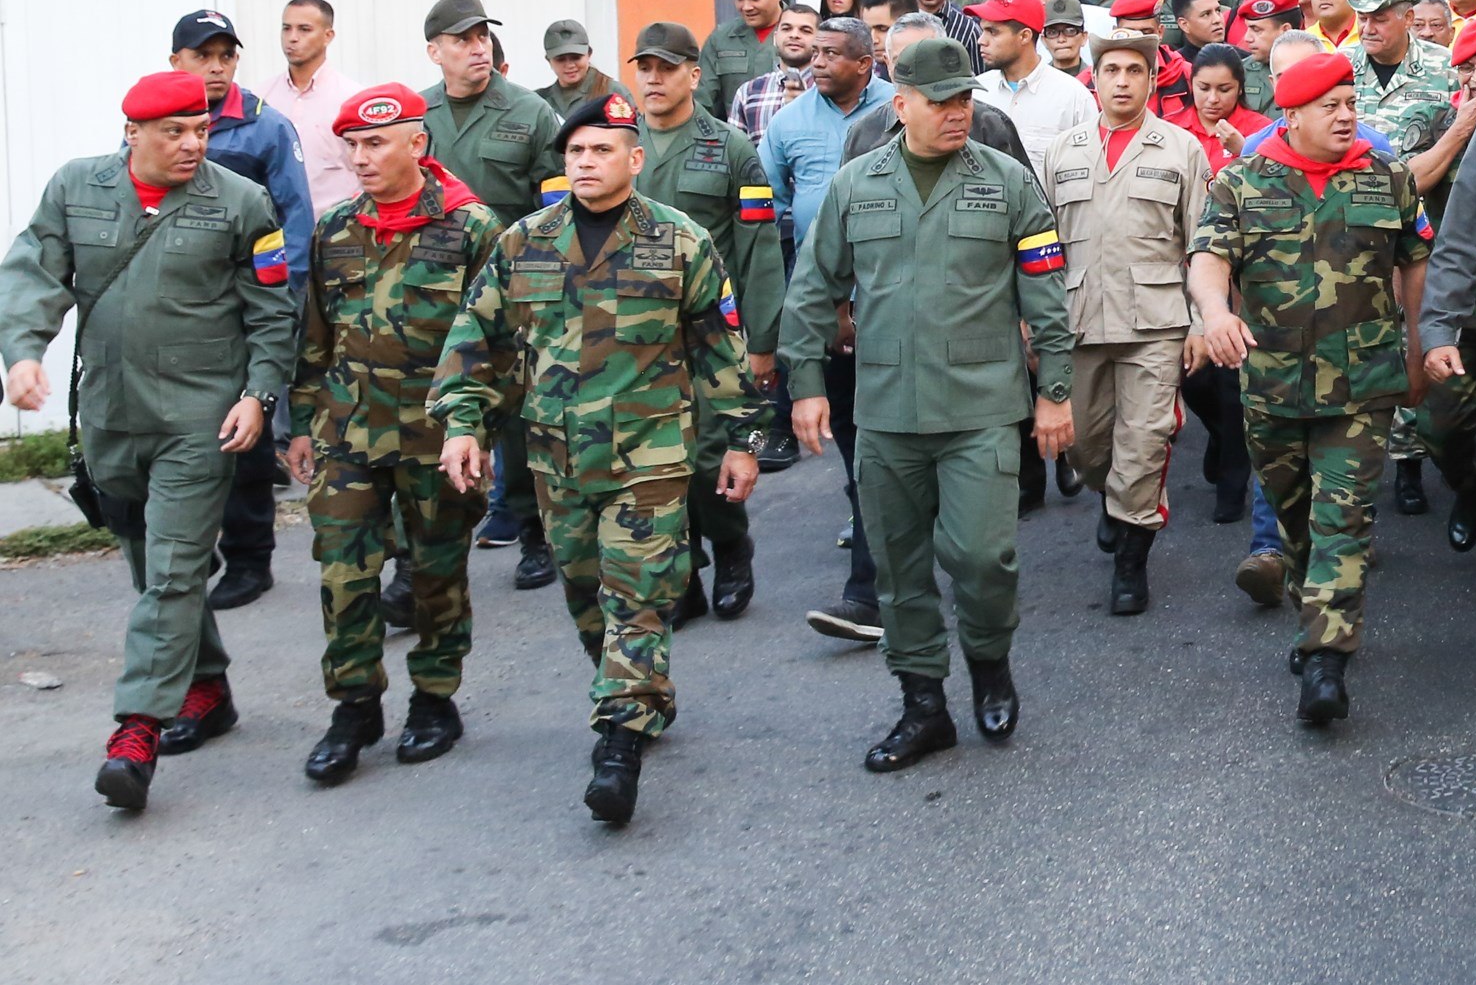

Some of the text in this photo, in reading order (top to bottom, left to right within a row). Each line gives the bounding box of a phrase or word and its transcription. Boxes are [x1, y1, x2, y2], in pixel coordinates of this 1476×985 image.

[365, 104, 395, 115] 4F92
[858, 201, 885, 210] PADRINO
[967, 202, 997, 210] FANB
